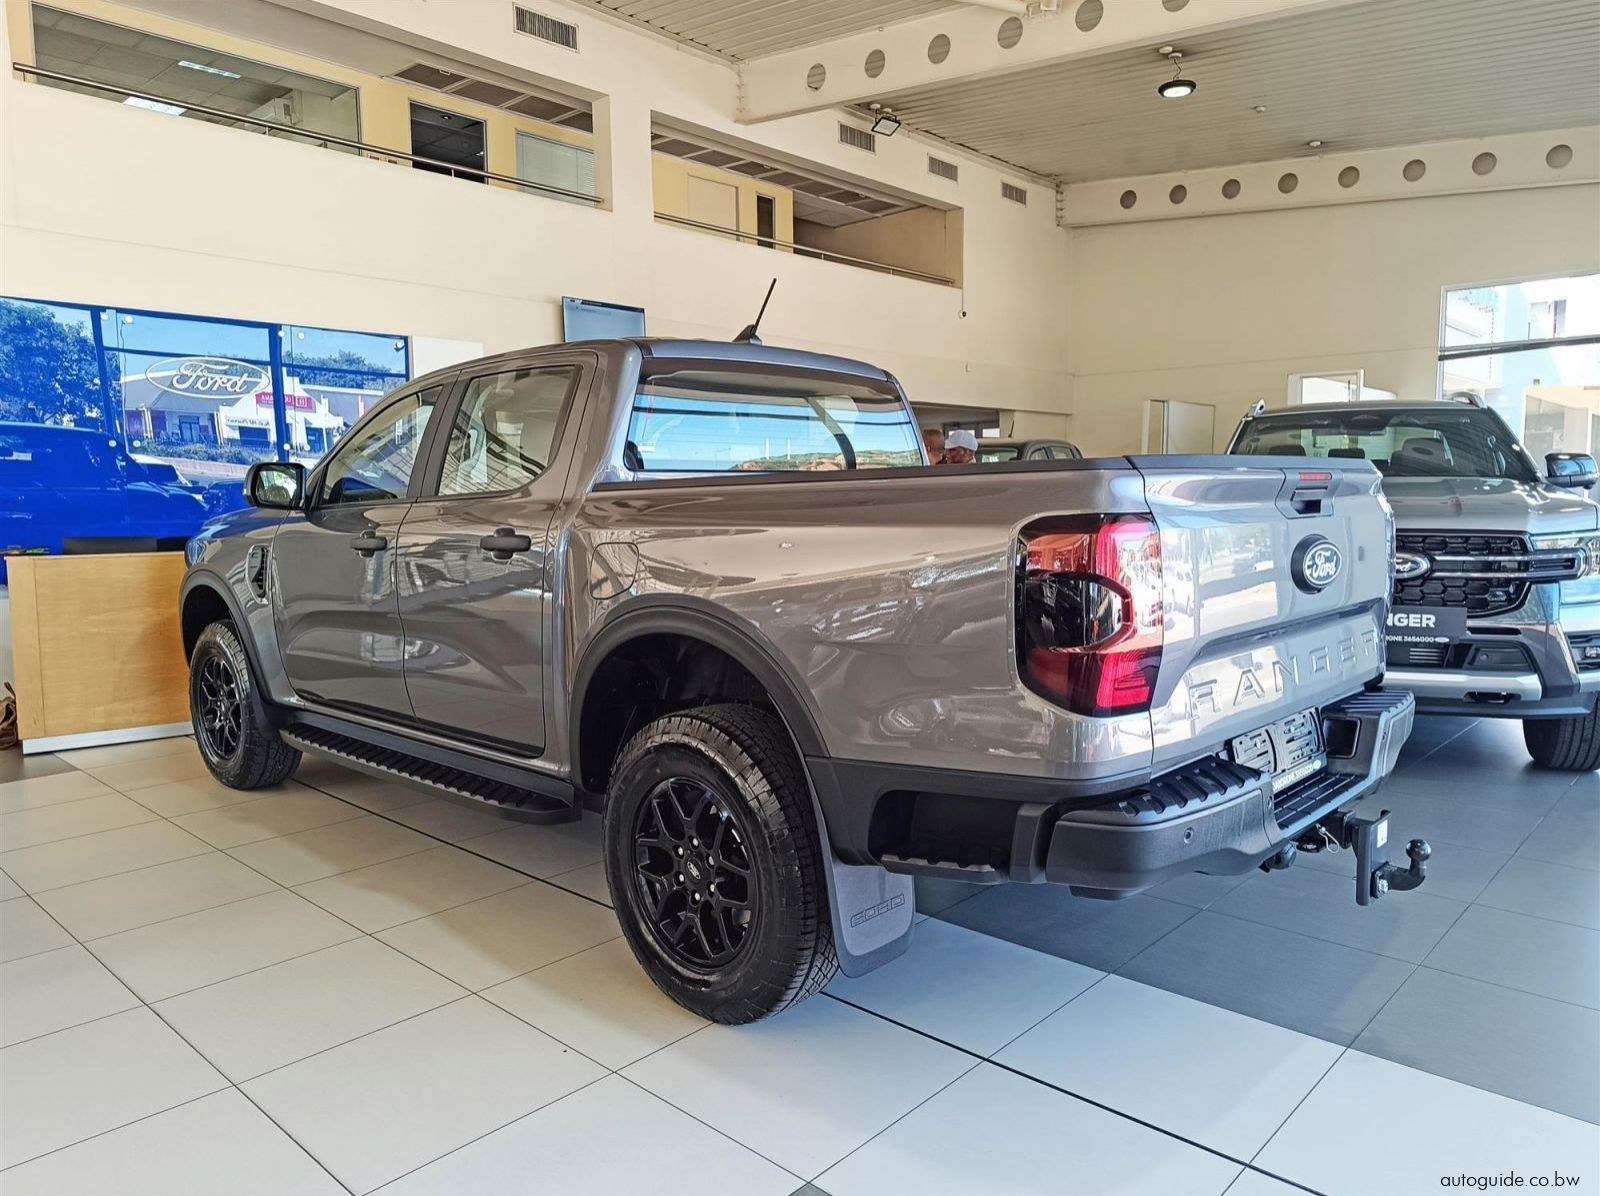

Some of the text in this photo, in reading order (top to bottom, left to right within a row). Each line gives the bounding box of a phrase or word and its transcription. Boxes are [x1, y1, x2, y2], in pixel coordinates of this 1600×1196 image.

[172, 362, 248, 392] Ford
[1312, 550, 1337, 578] Ford
[1187, 629, 1378, 719] RANGER
[850, 893, 905, 928] FORD
